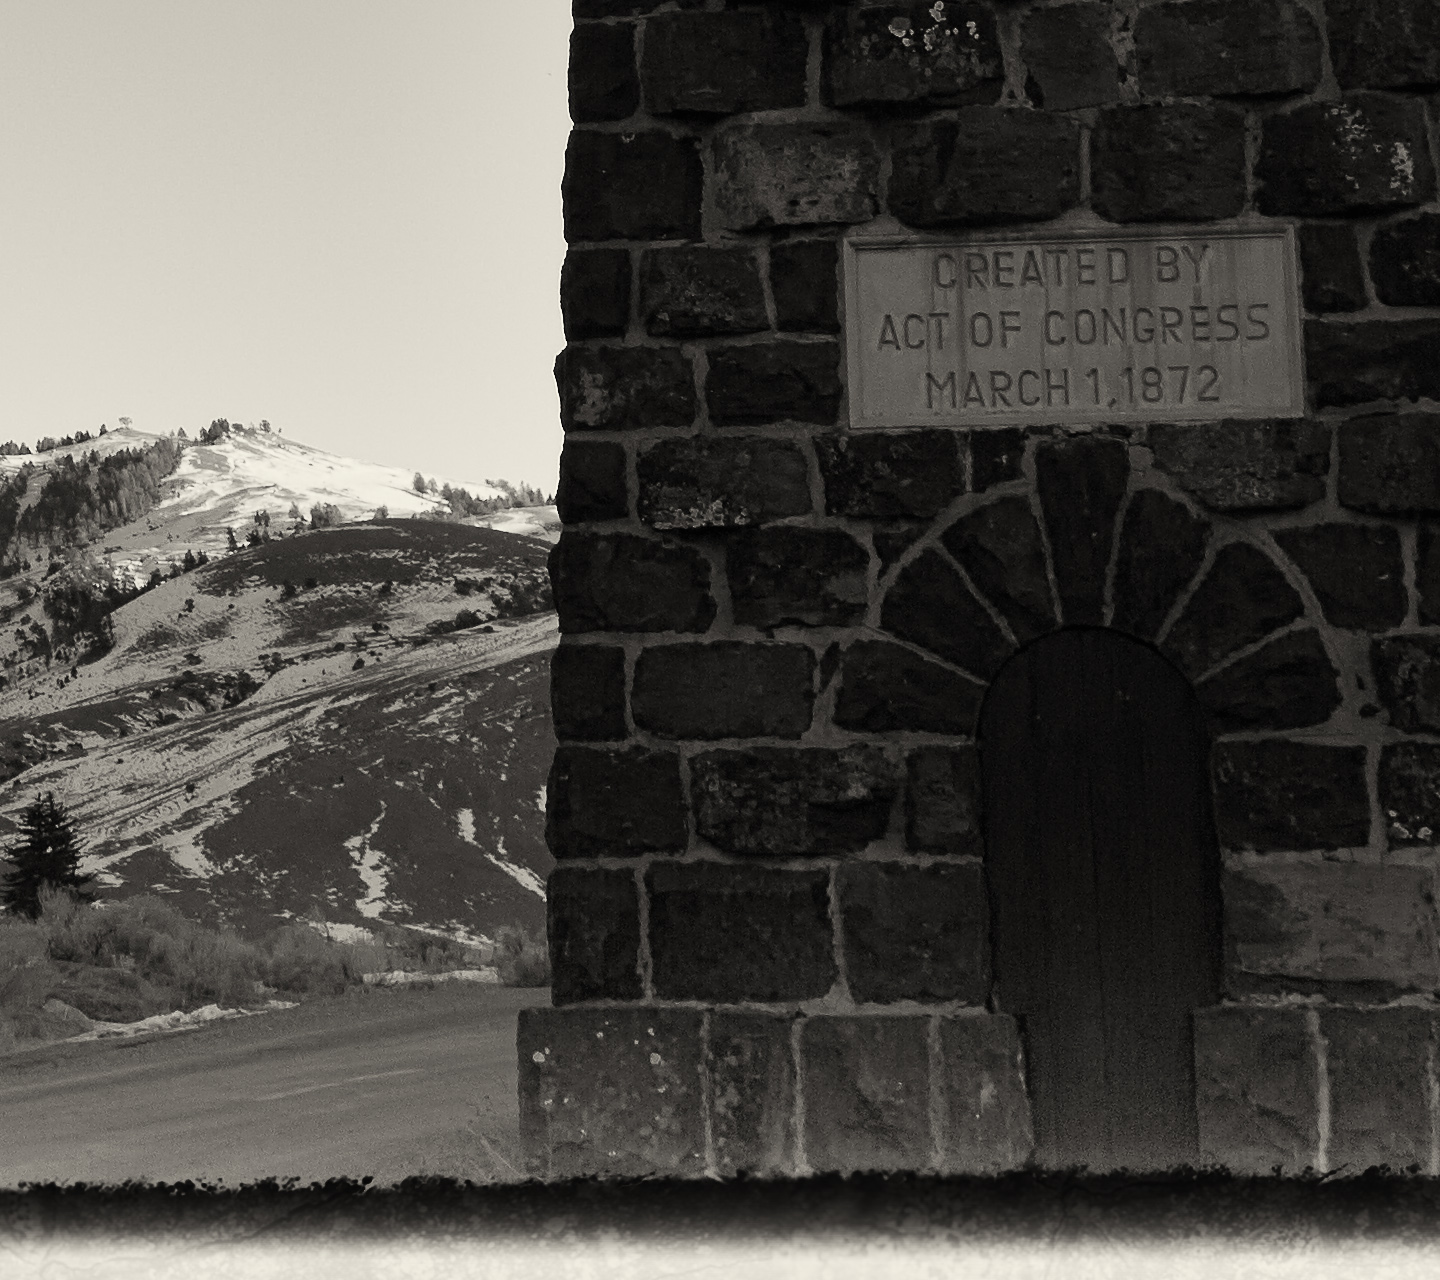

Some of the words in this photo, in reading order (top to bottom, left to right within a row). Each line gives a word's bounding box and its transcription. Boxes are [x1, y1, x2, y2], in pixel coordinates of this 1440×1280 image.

[933, 248, 1128, 289] CREATED
[1156, 244, 1210, 283] BY
[877, 312, 949, 351] ACT
[969, 310, 1022, 349] OF
[1044, 303, 1271, 347] CONGRESS
[925, 368, 1071, 410] MARCH
